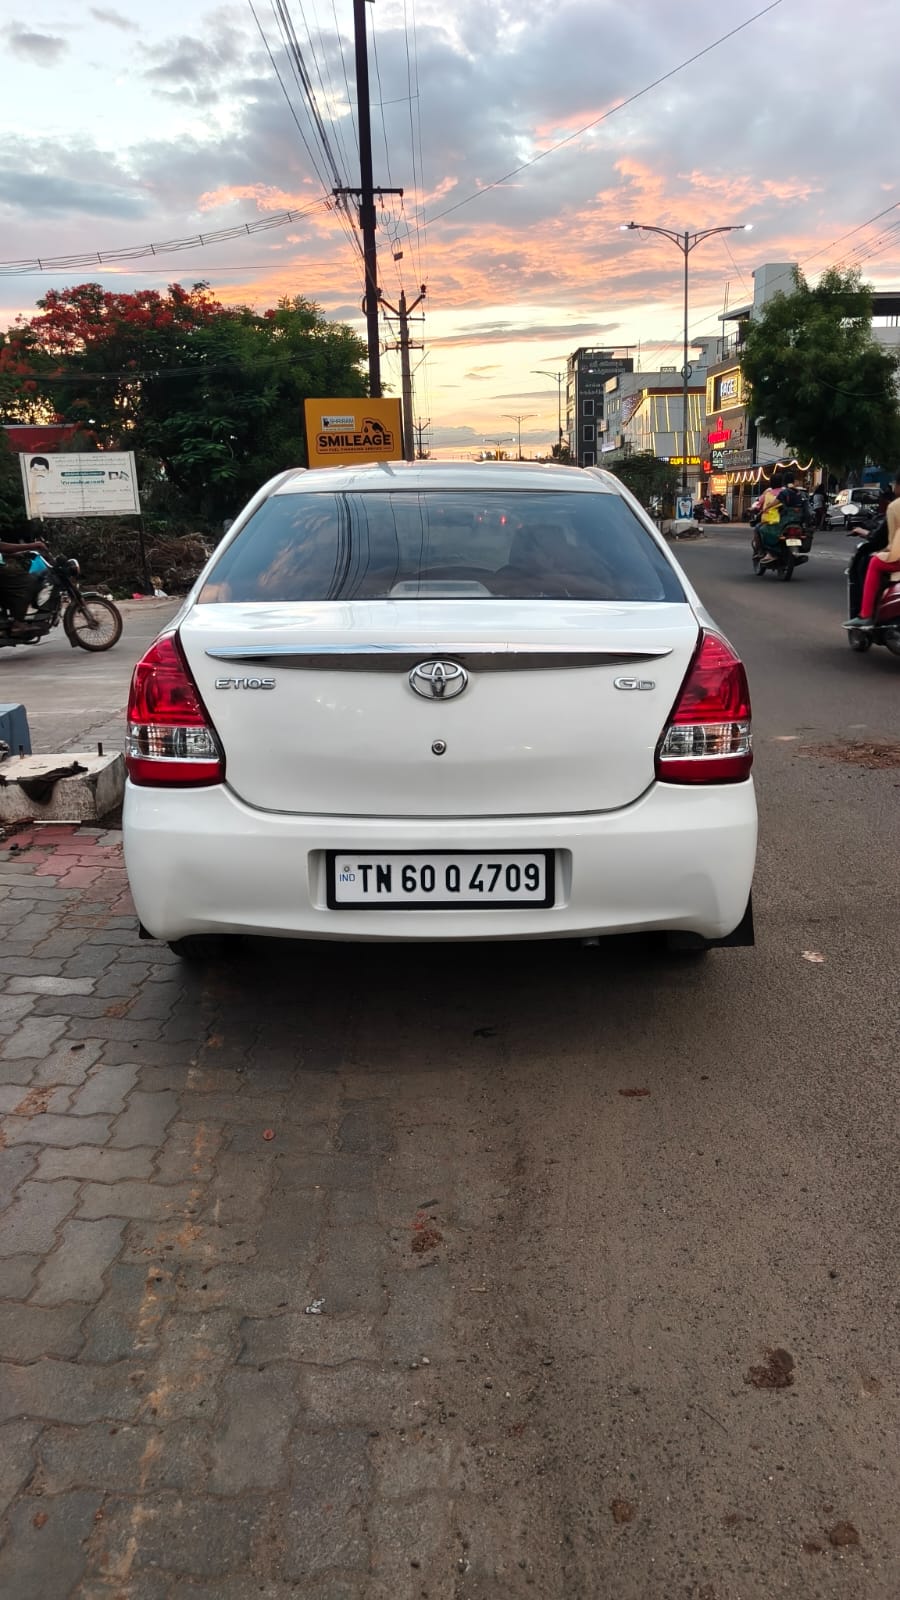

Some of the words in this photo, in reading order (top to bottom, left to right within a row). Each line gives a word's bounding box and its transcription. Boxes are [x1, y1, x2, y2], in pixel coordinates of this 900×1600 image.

[319, 434, 391, 447] SMILEAGE
[215, 678, 276, 690] ETIOS
[613, 676, 656, 691] GD
[339, 873, 356, 882] IND
[357, 864, 392, 893] TN
[401, 864, 436, 893] 60
[445, 864, 461, 893] Q
[468, 863, 540, 893] 4709
